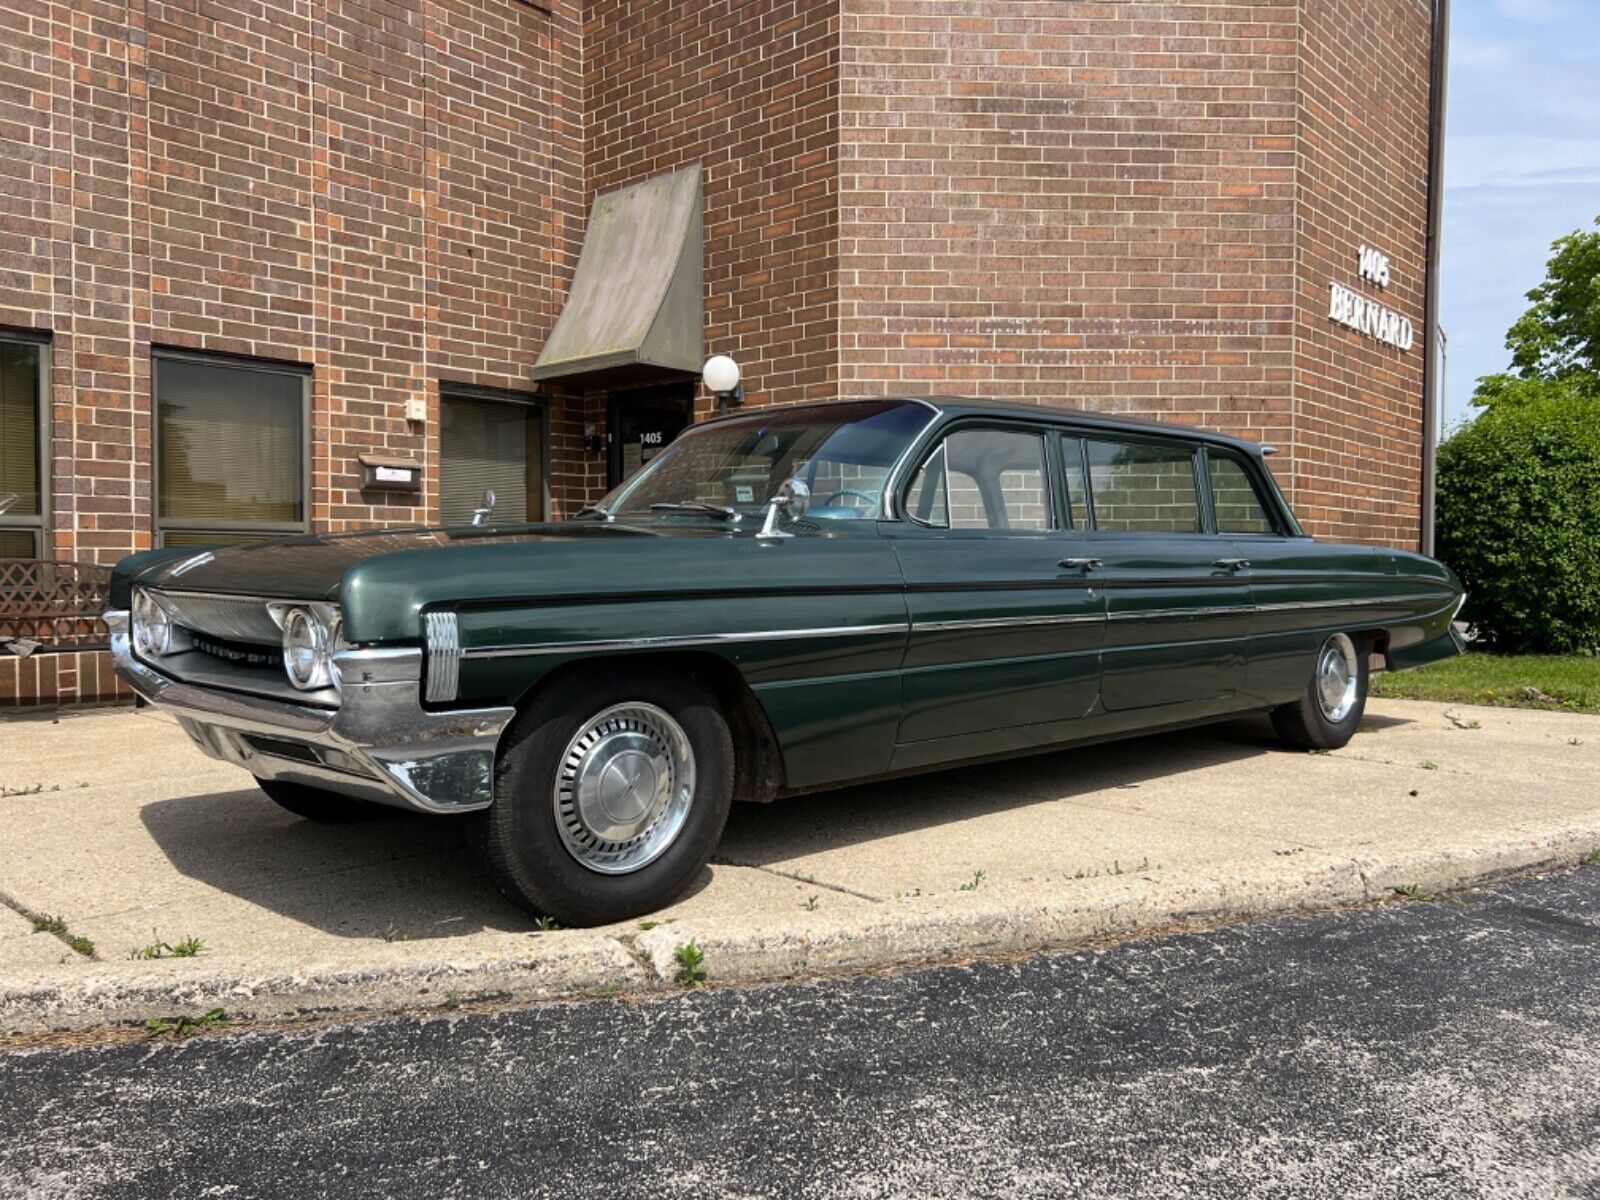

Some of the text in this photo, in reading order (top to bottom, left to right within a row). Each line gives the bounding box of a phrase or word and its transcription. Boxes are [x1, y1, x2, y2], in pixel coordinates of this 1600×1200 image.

[1358, 244, 1390, 287] 1405
[1328, 281, 1413, 350] BERNARD
[640, 431, 662, 444] 1405
